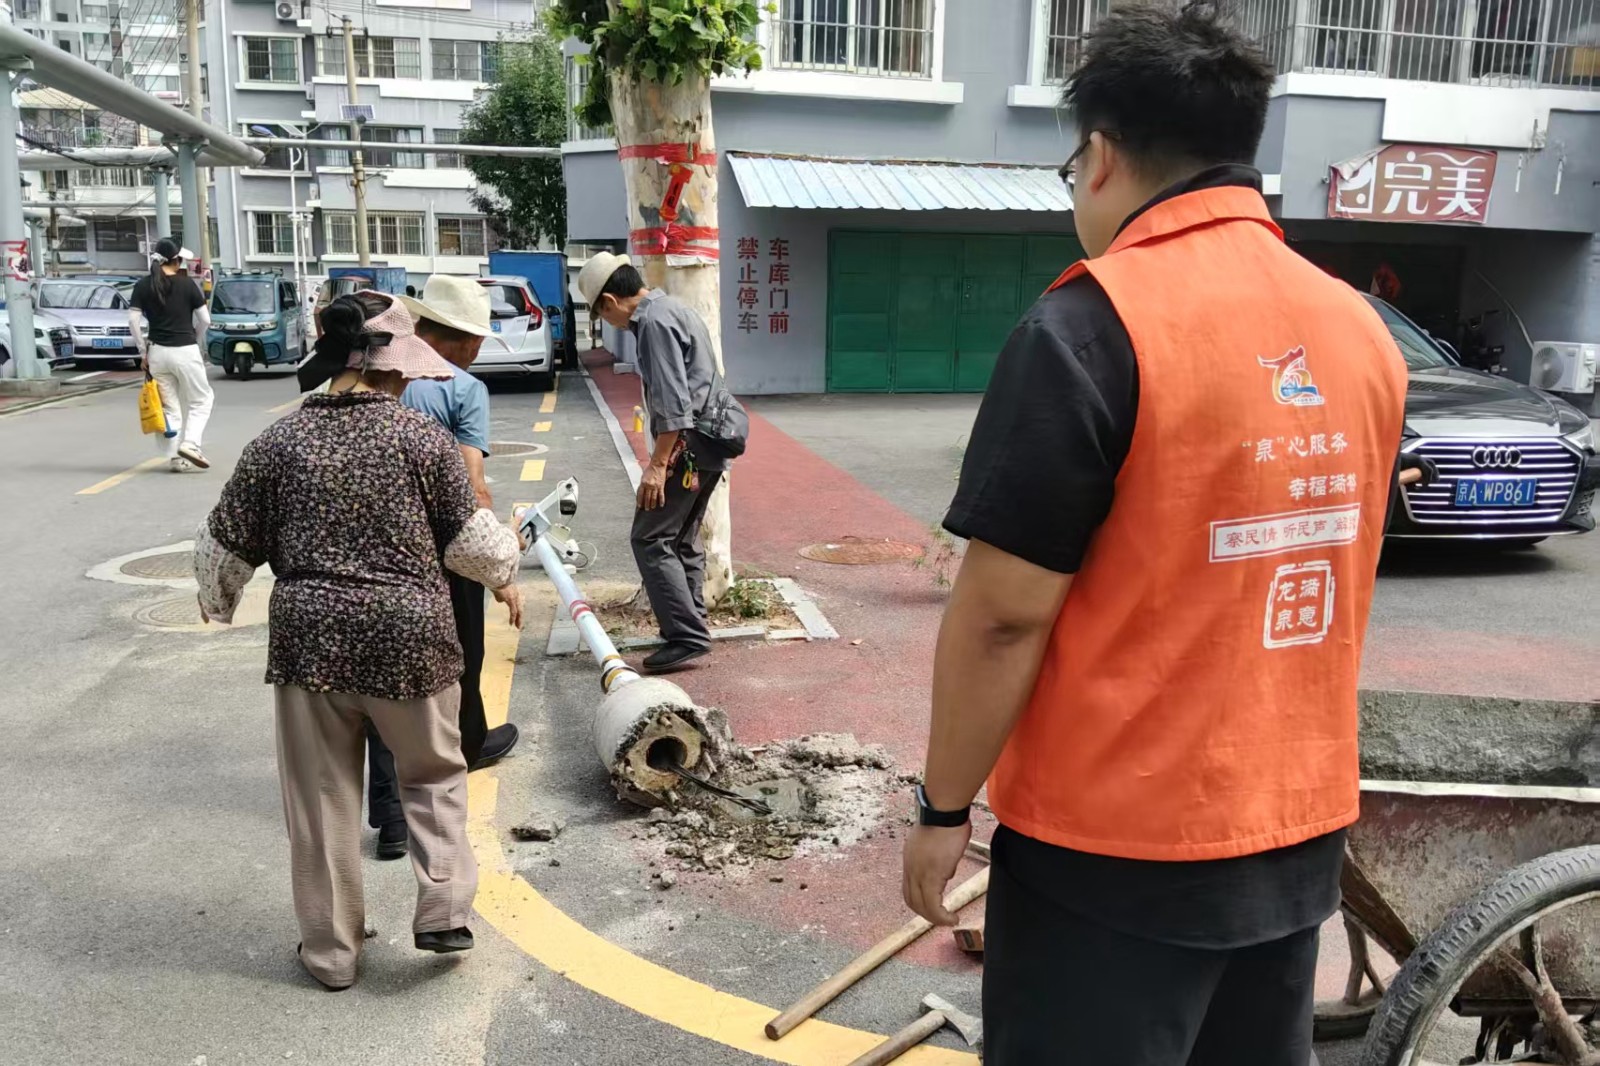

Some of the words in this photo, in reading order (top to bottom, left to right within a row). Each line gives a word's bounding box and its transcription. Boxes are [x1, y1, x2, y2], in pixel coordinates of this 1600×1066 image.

[1381, 150, 1489, 216] 完美
[737, 237, 759, 334] 禁止停车
[768, 237, 790, 334] 车库门前
